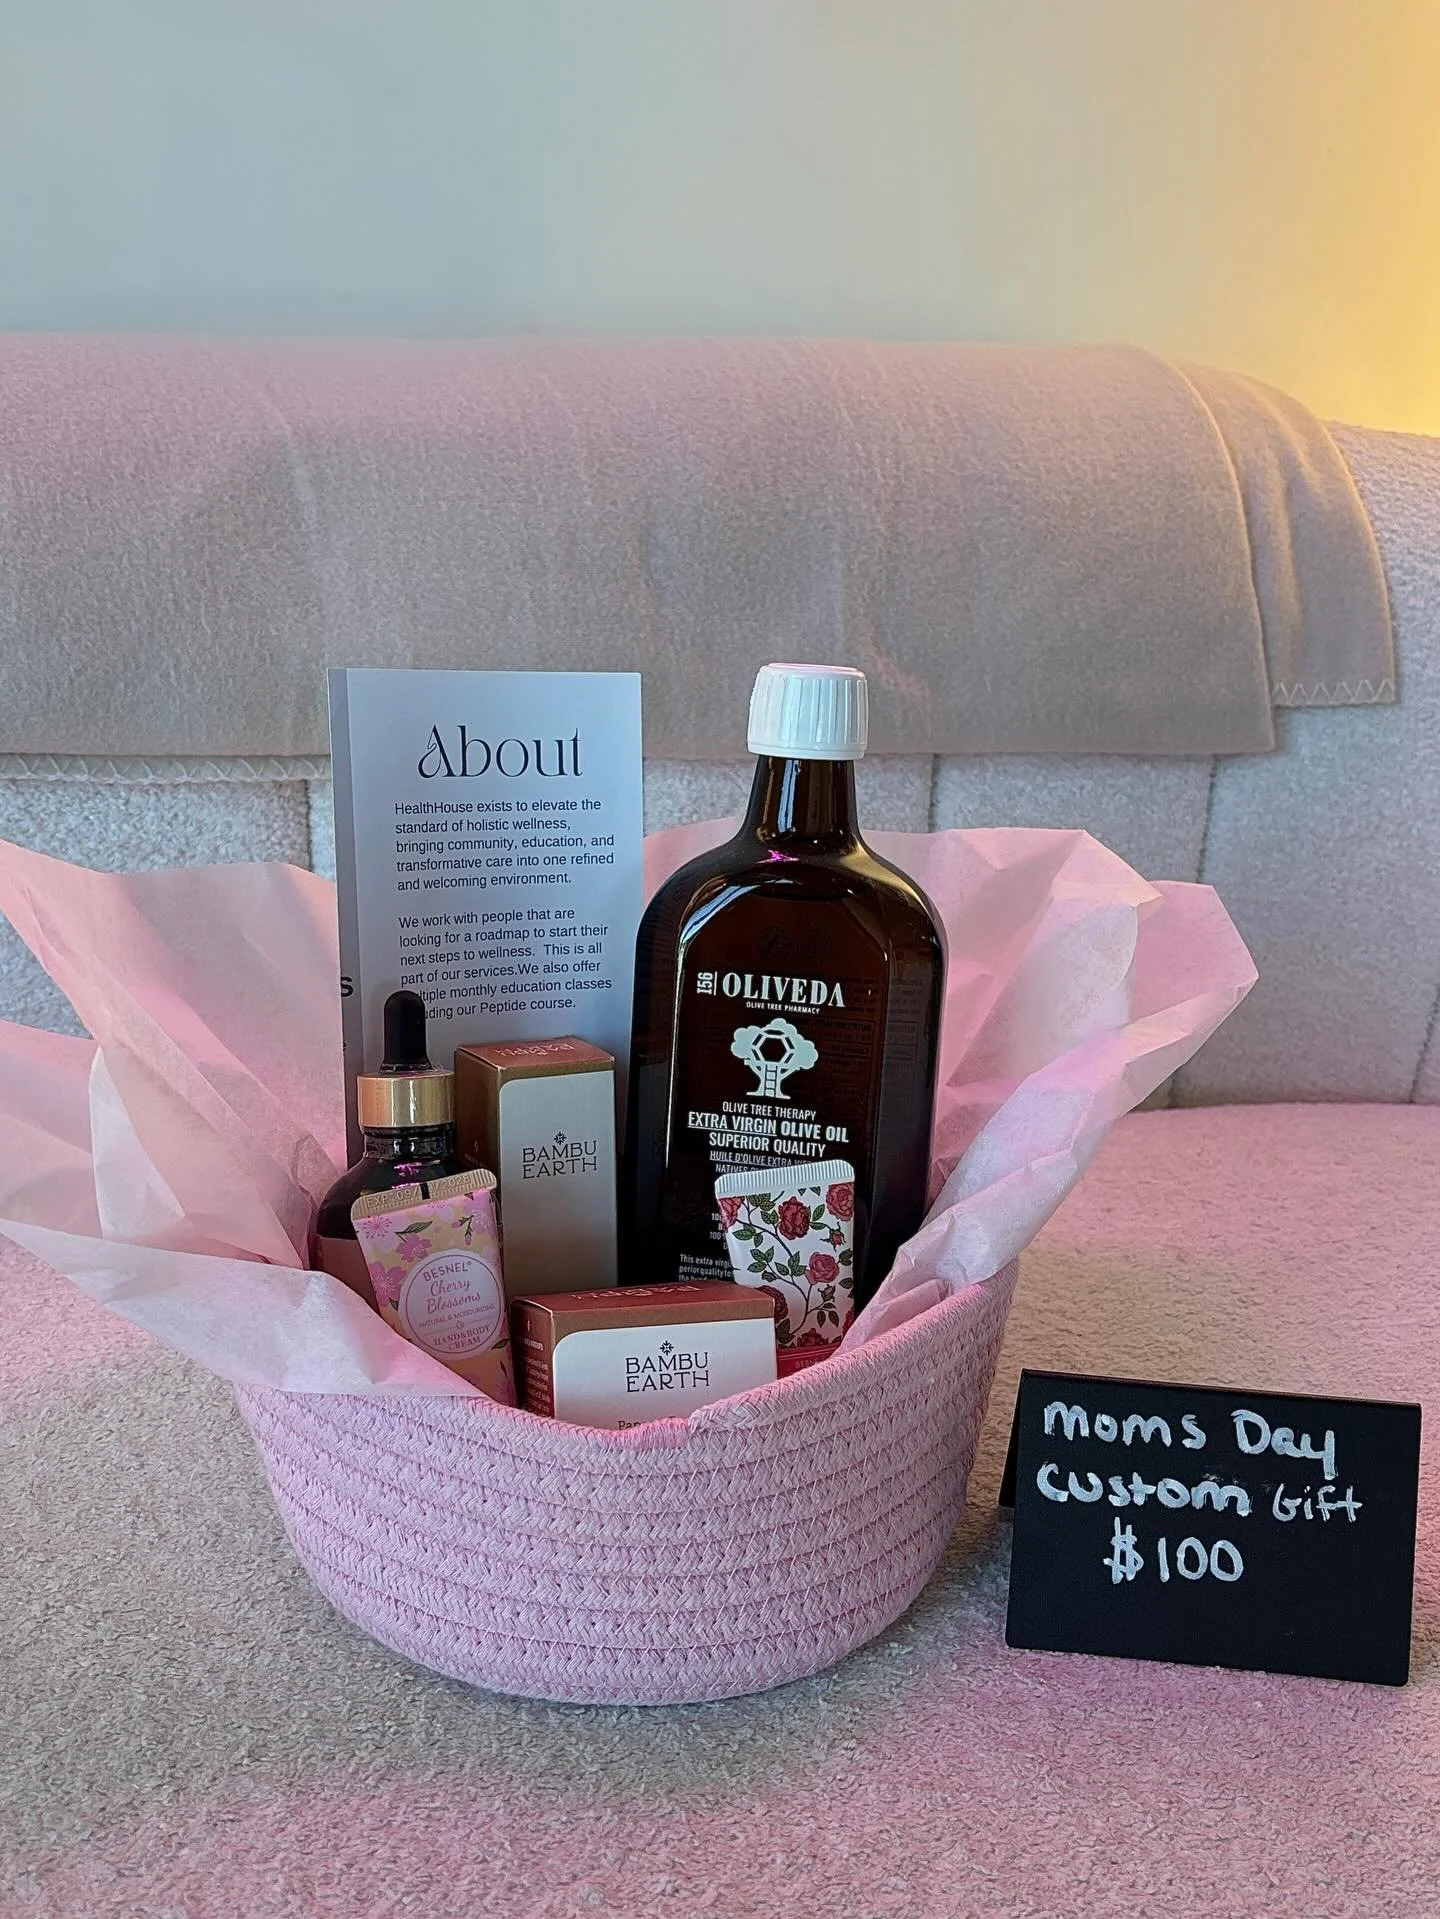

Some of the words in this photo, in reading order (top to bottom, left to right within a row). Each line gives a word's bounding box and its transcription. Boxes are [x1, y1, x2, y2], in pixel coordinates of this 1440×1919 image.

[417, 724, 583, 779] About
[394, 802, 473, 815] HealthHouse
[477, 800, 512, 813] exists
[516, 800, 528, 812] to
[532, 799, 577, 811] elevate
[581, 799, 601, 810] the
[395, 820, 448, 834] standard
[451, 819, 464, 832] of
[467, 819, 509, 832] holistic
[512, 818, 571, 831] wellness,
[396, 840, 444, 855] bringing
[447, 837, 518, 851] community,
[521, 836, 587, 849] education,
[591, 834, 614, 847] and
[397, 858, 482, 872] transformative
[486, 856, 513, 868] care
[516, 854, 539, 867] into
[543, 856, 567, 866] one
[570, 852, 614, 865] refined
[398, 877, 420, 891] and
[423, 875, 487, 889] welcoming
[491, 872, 572, 886] environment.
[398, 916, 419, 929] We
[422, 914, 451, 927] work
[453, 911, 478, 925] with
[481, 909, 523, 926] people
[527, 908, 551, 920] that
[554, 909, 575, 920] are
[399, 933, 441, 948] looking
[444, 931, 460, 943] for
[463, 933, 472, 943] a
[475, 928, 530, 942] roadmap
[533, 927, 545, 938] to
[549, 925, 577, 938] start
[580, 924, 608, 936] their
[400, 954, 426, 967] next
[428, 951, 461, 965] steps
[463, 949, 475, 961] to
[478, 945, 536, 960] wellness.
[543, 943, 570, 956] This
[573, 943, 584, 955] is
[587, 941, 602, 954] all
[400, 973, 424, 988] part
[426, 970, 439, 984] of
[441, 969, 460, 981] our
[542, 962, 569, 974] also
[572, 961, 601, 972] offer
[450, 983, 497, 999] monthly
[500, 979, 561, 995] education
[565, 977, 612, 991] classes
[722, 972, 846, 1008] OLIVEDA
[456, 1005, 477, 1017] our
[480, 998, 527, 1015] Peptide
[530, 998, 576, 1010] course.
[746, 1001, 765, 1011] OLIVE
[767, 1003, 783, 1011] TREE
[784, 1005, 820, 1015] PHARMACY
[722, 1101, 748, 1115] OLIVE
[750, 1104, 772, 1117] TREE
[775, 1106, 816, 1121] THERAPY
[688, 1111, 728, 1129] EXTRA
[732, 1115, 777, 1135] VIRGIN
[780, 1121, 821, 1140] OLIVE
[825, 1126, 849, 1143] OIL
[522, 1141, 597, 1163] BAMBU
[709, 1132, 769, 1151] SUPERIOR
[773, 1139, 826, 1158] QUALITY
[523, 1156, 597, 1179] EARTH
[709, 1150, 733, 1161] HUILE
[735, 1152, 766, 1165] D'OLIVE
[767, 1156, 791, 1167] EXTRA
[679, 1253, 694, 1264] This
[695, 1256, 713, 1266] extra
[715, 1258, 731, 1268] virg
[430, 1279, 470, 1297] Cherry
[426, 1292, 481, 1314] Blossoms
[448, 1337, 481, 1350] CREAM
[625, 1352, 709, 1374] BAMBU
[626, 1370, 710, 1393] EARTH
[1231, 1408, 1338, 1480] Day
[1272, 1483, 1363, 1523] Gift
[1103, 1517, 1244, 1584] $100
